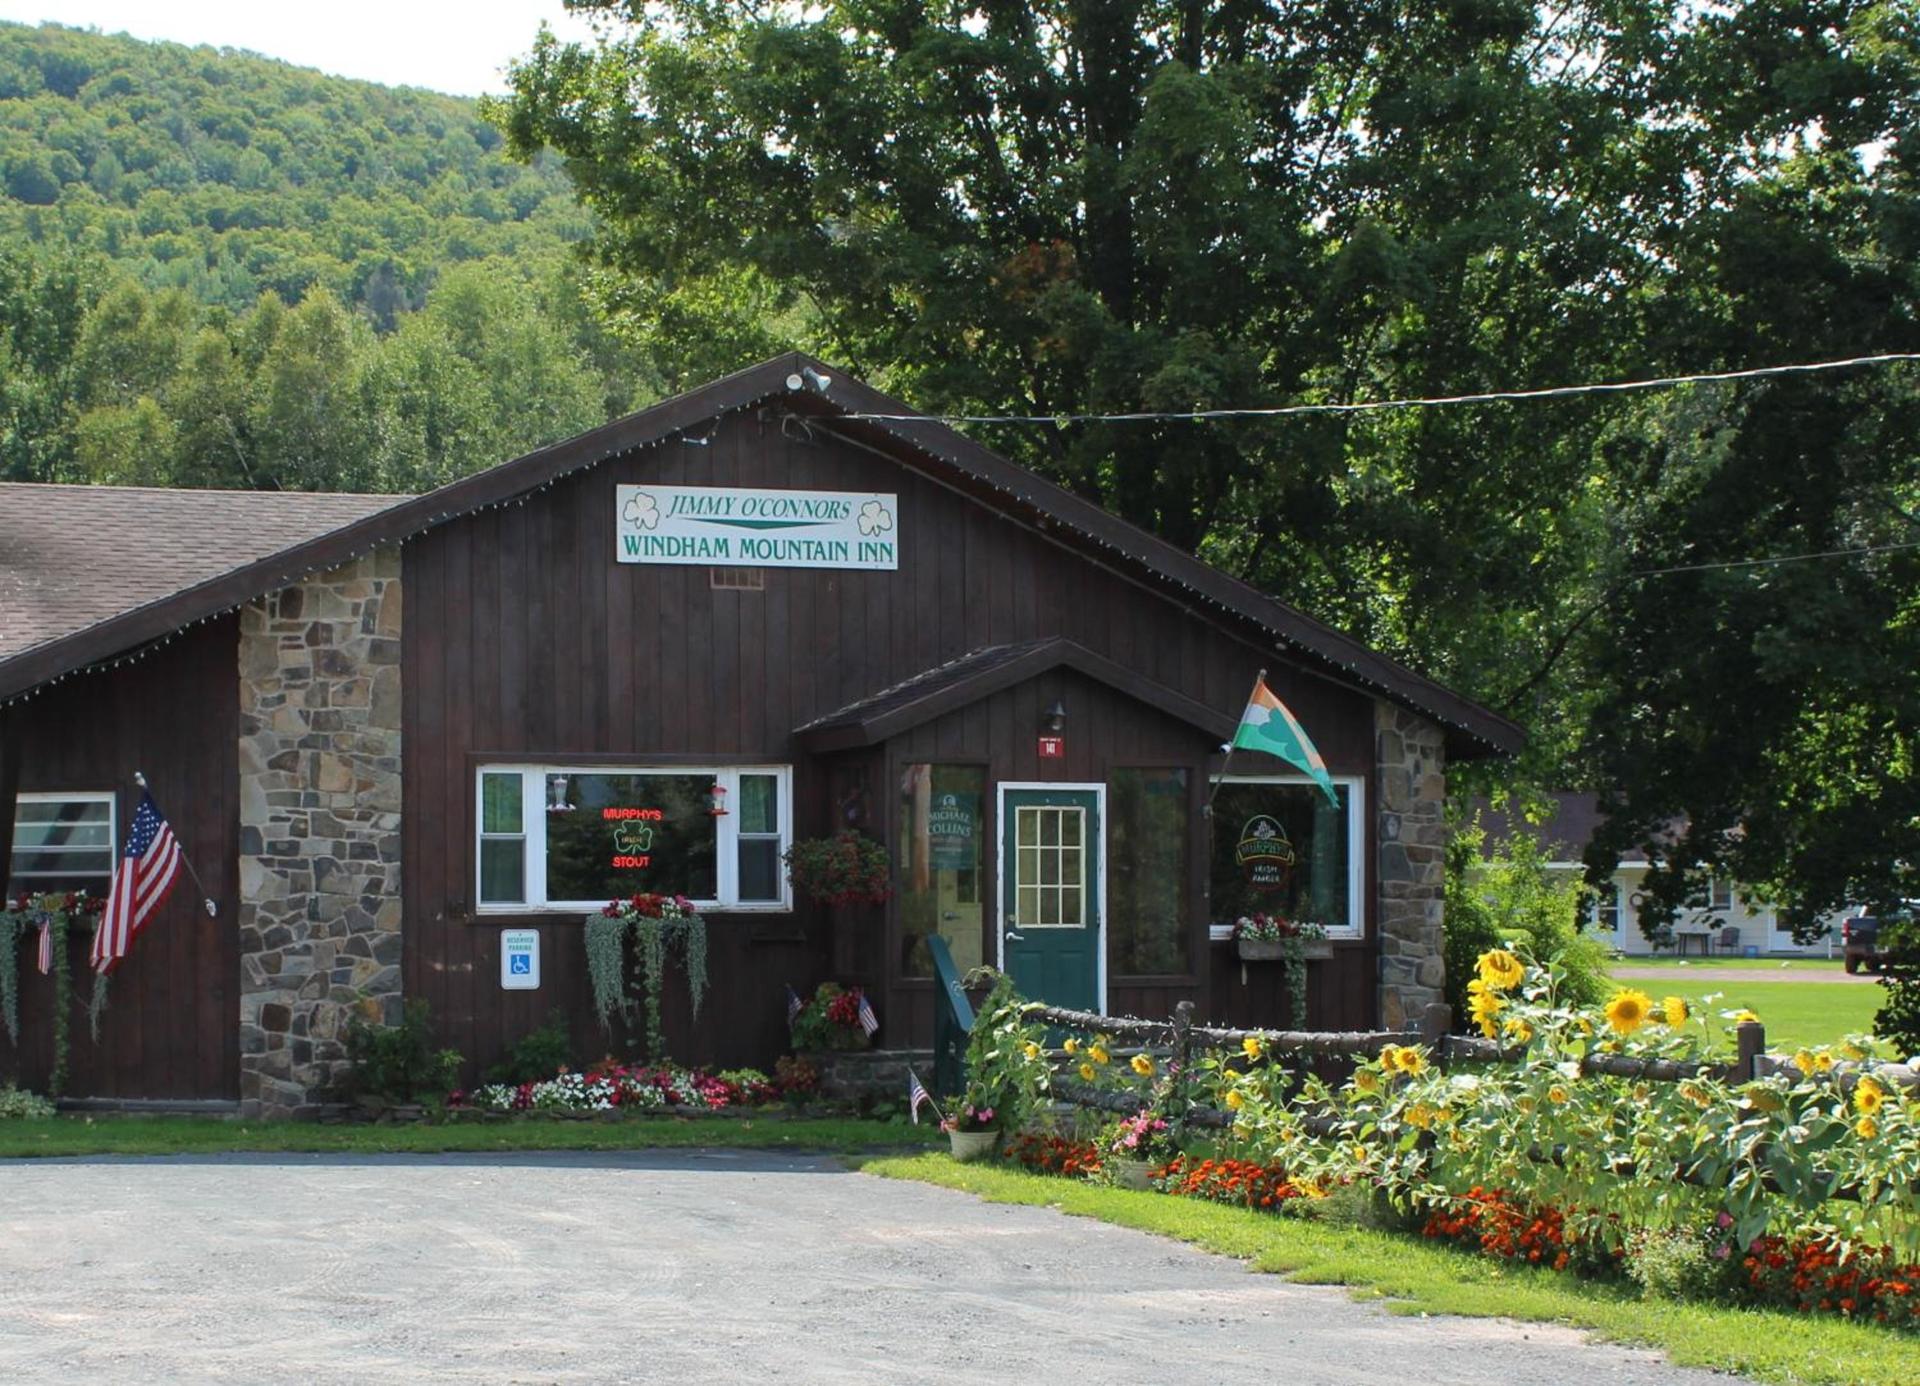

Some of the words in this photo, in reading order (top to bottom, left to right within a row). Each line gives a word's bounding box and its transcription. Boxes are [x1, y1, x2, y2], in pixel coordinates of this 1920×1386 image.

[665, 494, 737, 518] JIMMY
[741, 497, 852, 520] O'CONNORS
[622, 534, 730, 559] WINDHAM
[739, 538, 849, 562] MOUNTAIN
[857, 541, 894, 563] INN
[603, 808, 662, 820] MURPHY'S
[926, 823, 972, 837] COLLINS
[612, 856, 650, 868] STOUT
[1254, 865, 1279, 874] IRISH
